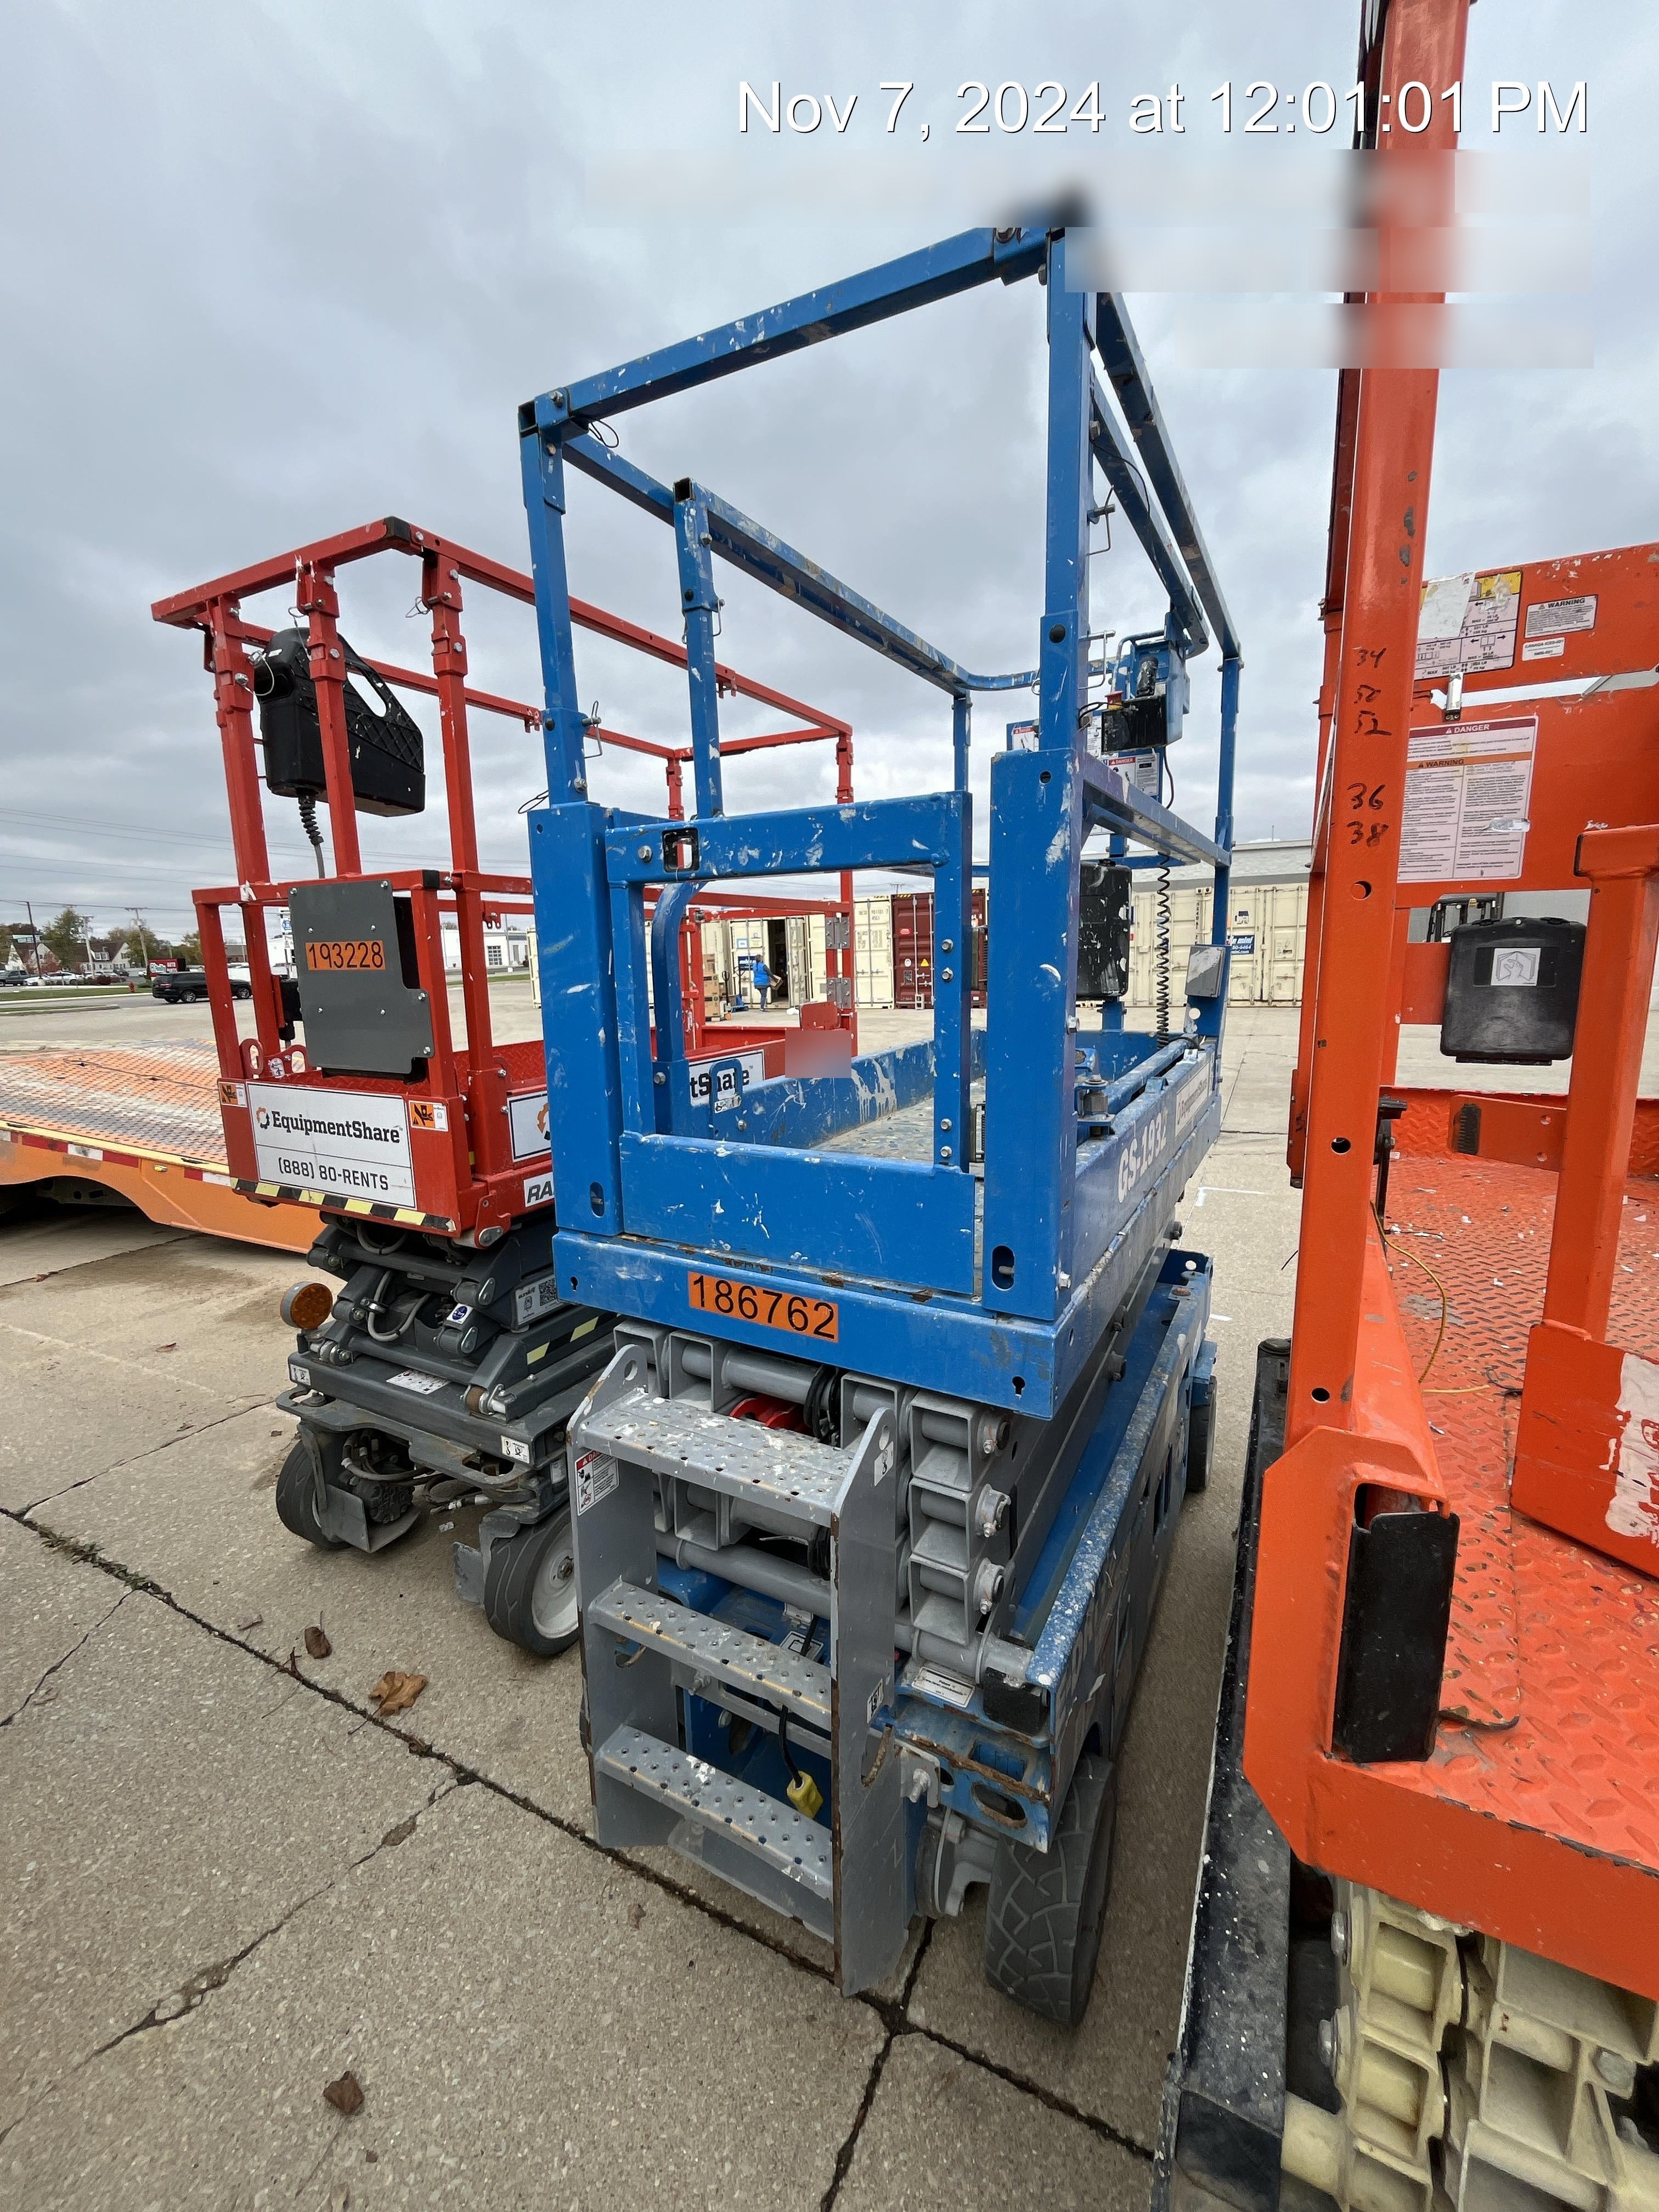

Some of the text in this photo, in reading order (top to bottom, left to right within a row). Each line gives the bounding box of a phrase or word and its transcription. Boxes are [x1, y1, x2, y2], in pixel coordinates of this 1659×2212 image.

[1547, 597, 1585, 608] WARNING
[1356, 648, 1387, 669] 34
[1453, 724, 1491, 734] DANGER
[1426, 758, 1464, 768] WARNING
[1347, 782, 1386, 810] 36
[1347, 821, 1389, 848] 38
[309, 941, 383, 969] 193228
[271, 1110, 400, 1143] EquipmentShare
[279, 1157, 388, 1191] (888) 80-RENTS
[693, 1275, 835, 1340] 186762
